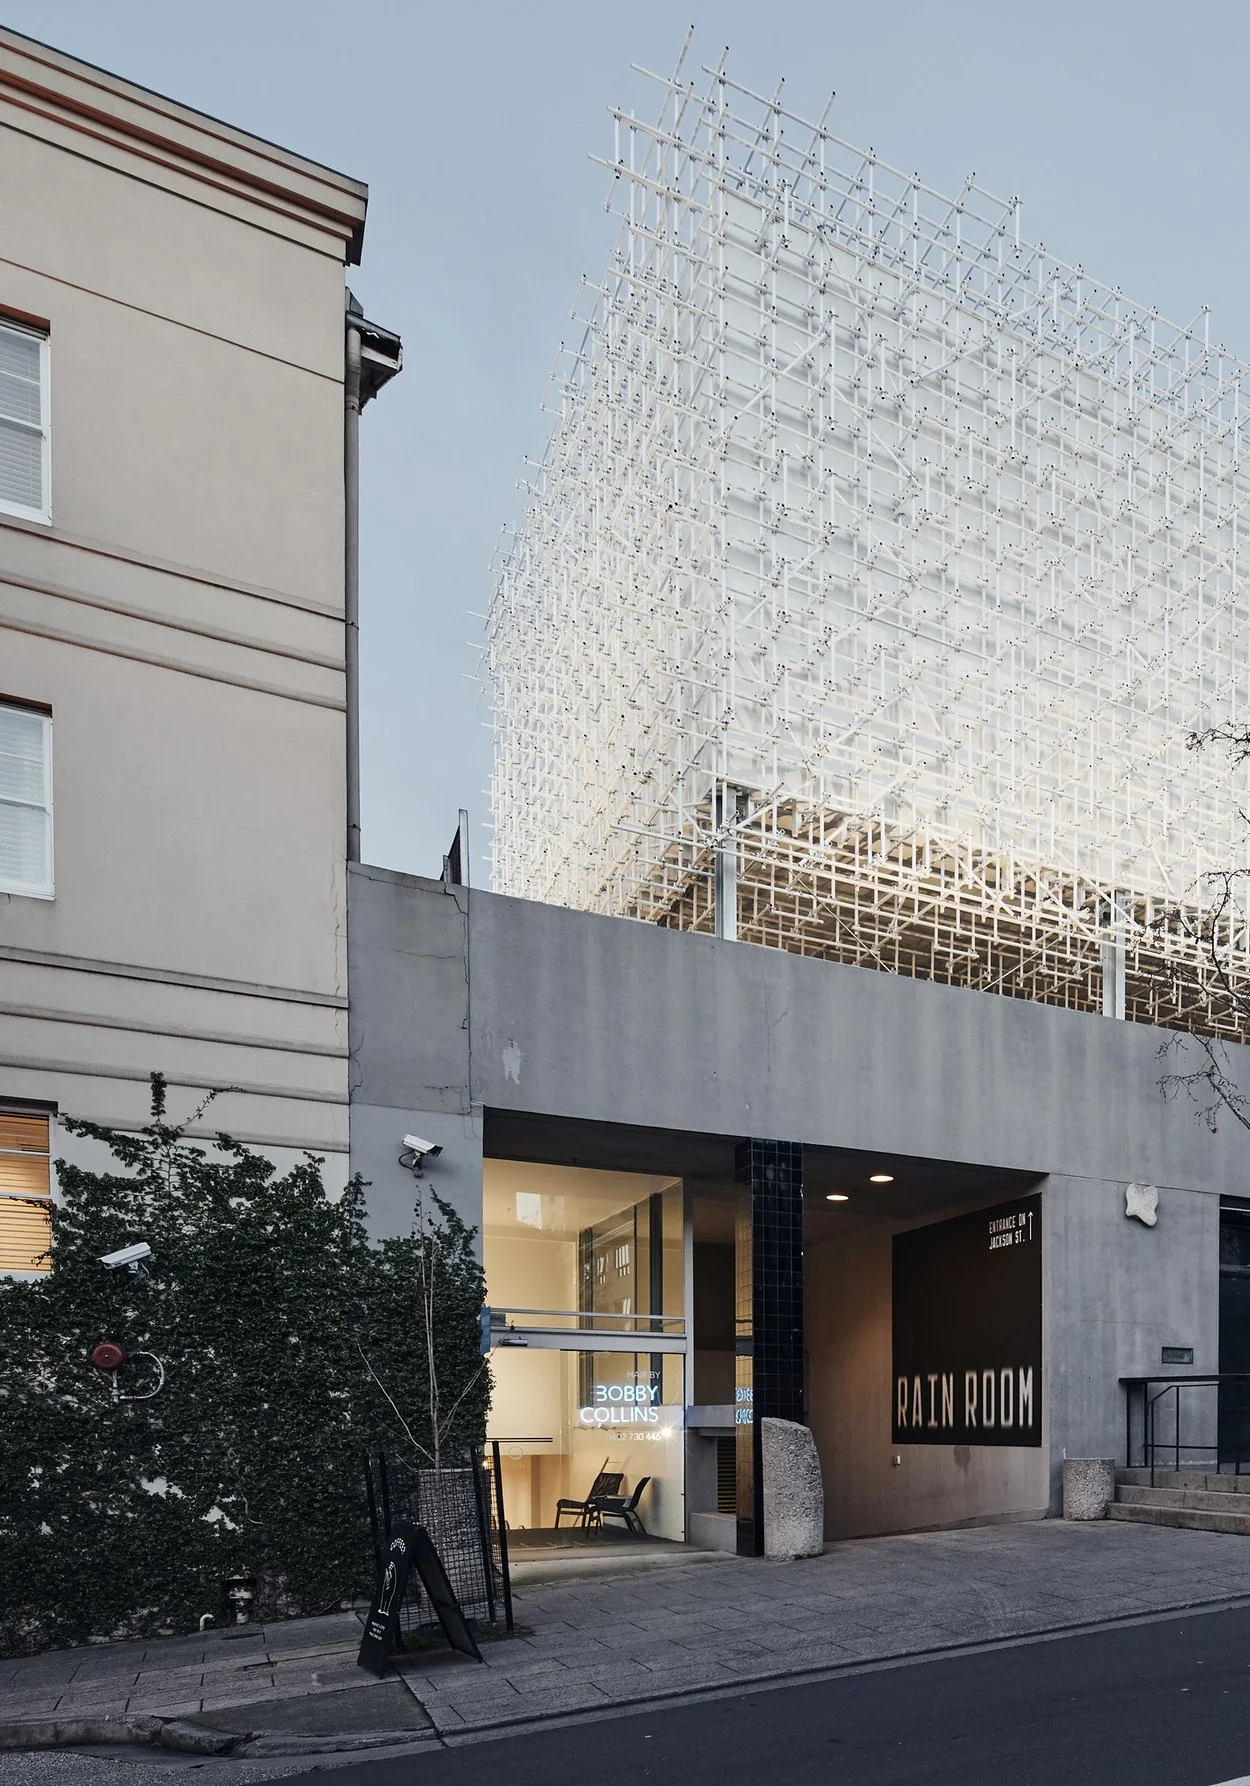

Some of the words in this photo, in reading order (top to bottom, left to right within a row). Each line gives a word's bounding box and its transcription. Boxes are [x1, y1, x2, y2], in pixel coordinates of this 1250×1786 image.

[990, 1215, 1015, 1233] ENTRANCE
[1019, 1213, 1025, 1226] ON
[990, 1233, 1012, 1249] JACKSON
[1015, 1230, 1025, 1243] ST.
[650, 1371, 661, 1379] BY
[596, 1385, 658, 1401] BOBBY
[898, 1372, 953, 1429] RAIN
[965, 1366, 1033, 1429] ROOM
[580, 1406, 659, 1422] COLLINS
[629, 1432, 644, 1440] 730
[645, 1432, 661, 1440] 446
